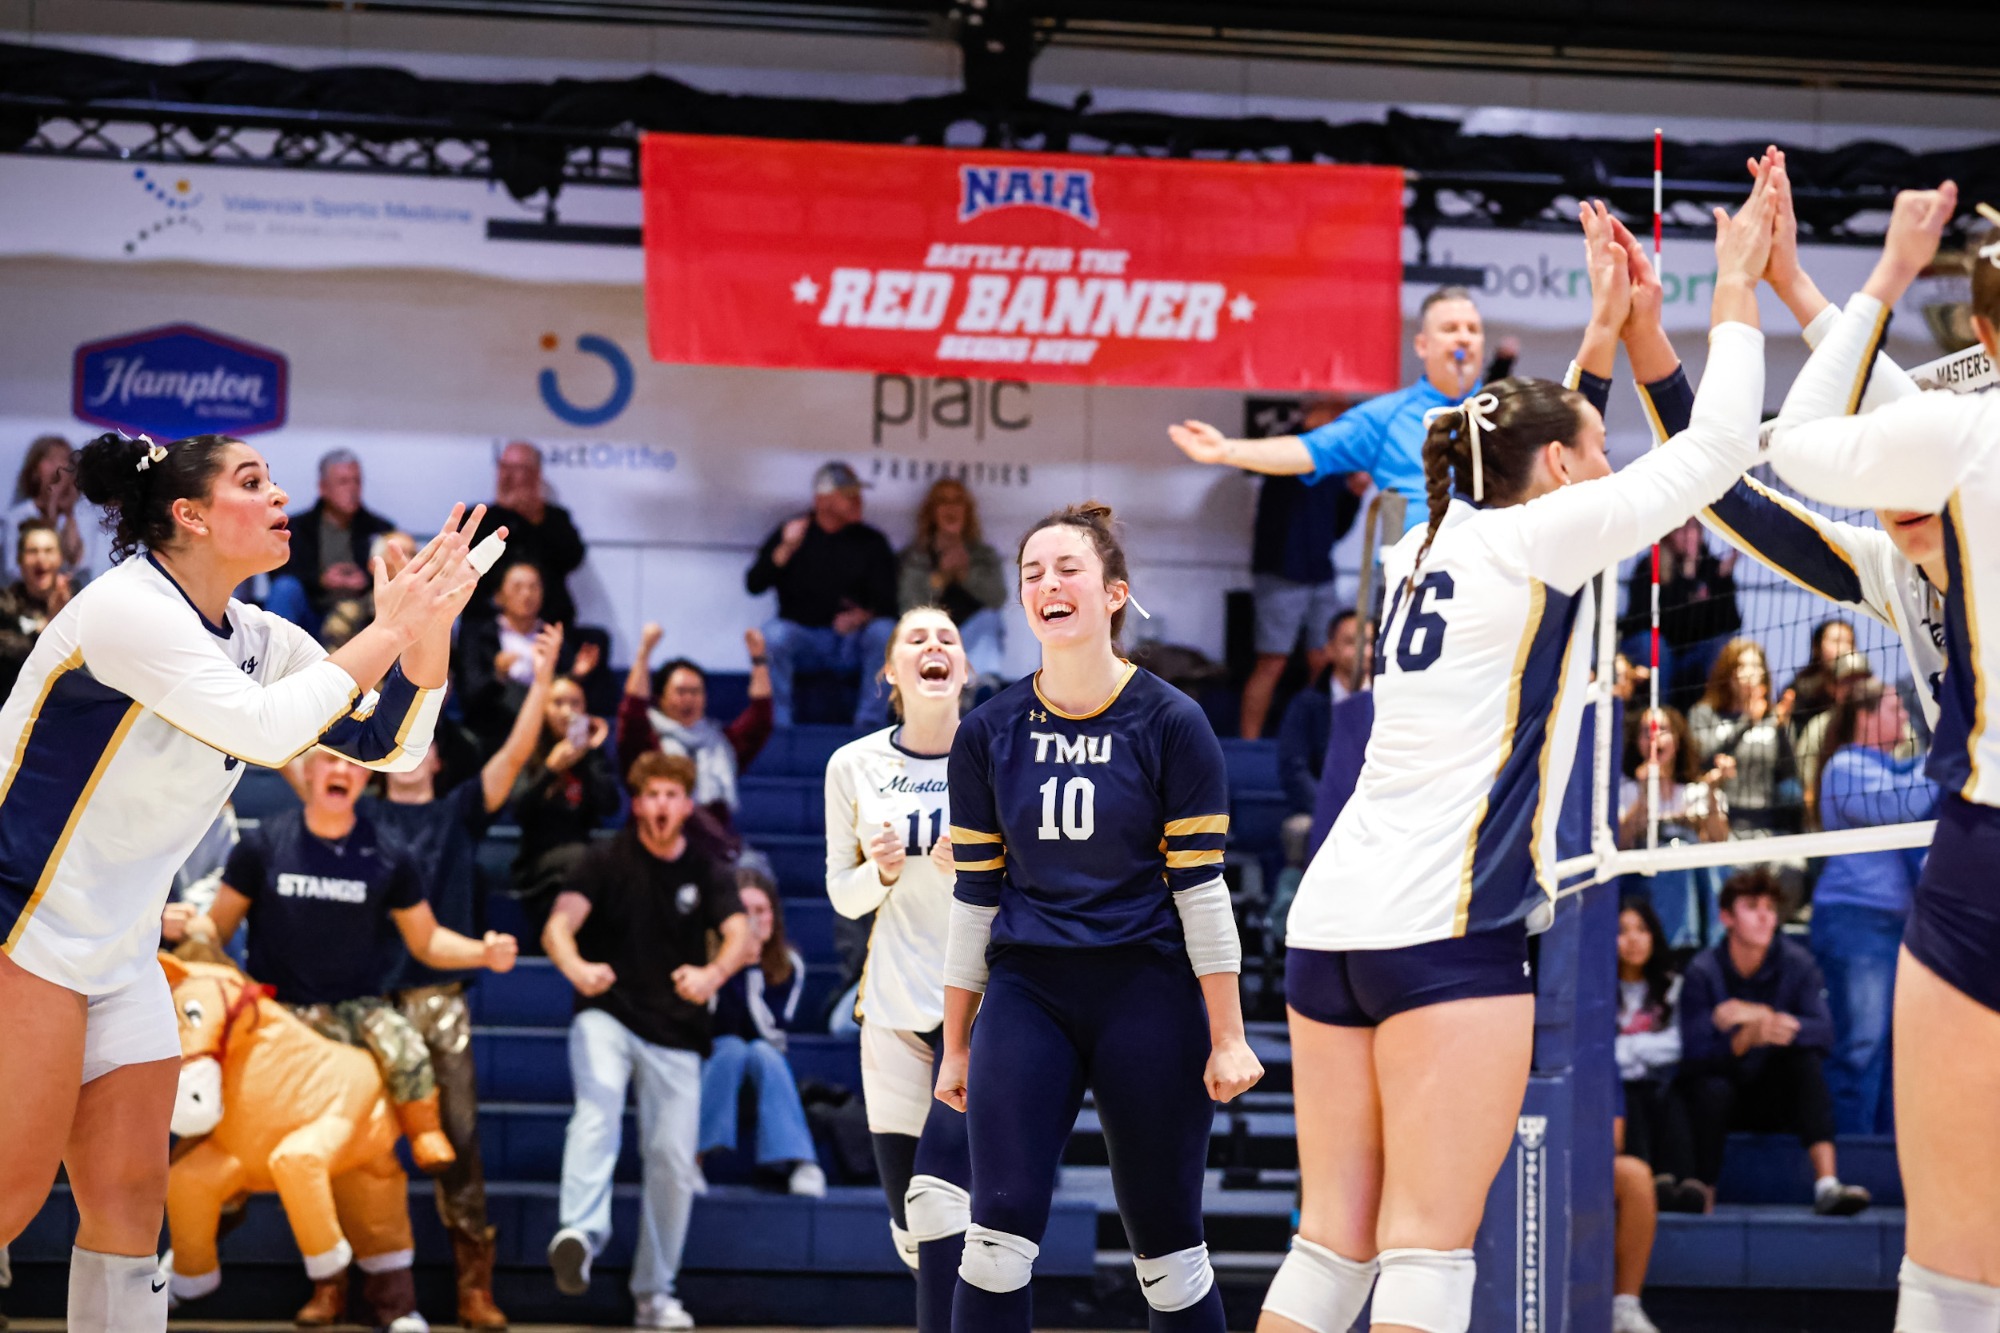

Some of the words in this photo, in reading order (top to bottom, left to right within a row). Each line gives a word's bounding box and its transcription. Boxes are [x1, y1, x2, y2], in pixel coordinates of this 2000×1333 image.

[957, 165, 1098, 229] NAIA
[924, 243, 1023, 271] BATTLE
[1023, 247, 1075, 273] FOR
[1078, 249, 1130, 275] THE
[818, 267, 954, 331] RED
[955, 274, 1227, 342] BANNER
[1030, 338, 1100, 365] NOW
[86, 355, 269, 409] Hampton
[1374, 570, 1455, 673] 16
[1029, 731, 1113, 765] TMU
[904, 808, 943, 856] 11
[1038, 776, 1096, 841] 10
[277, 872, 368, 904] STANGS
